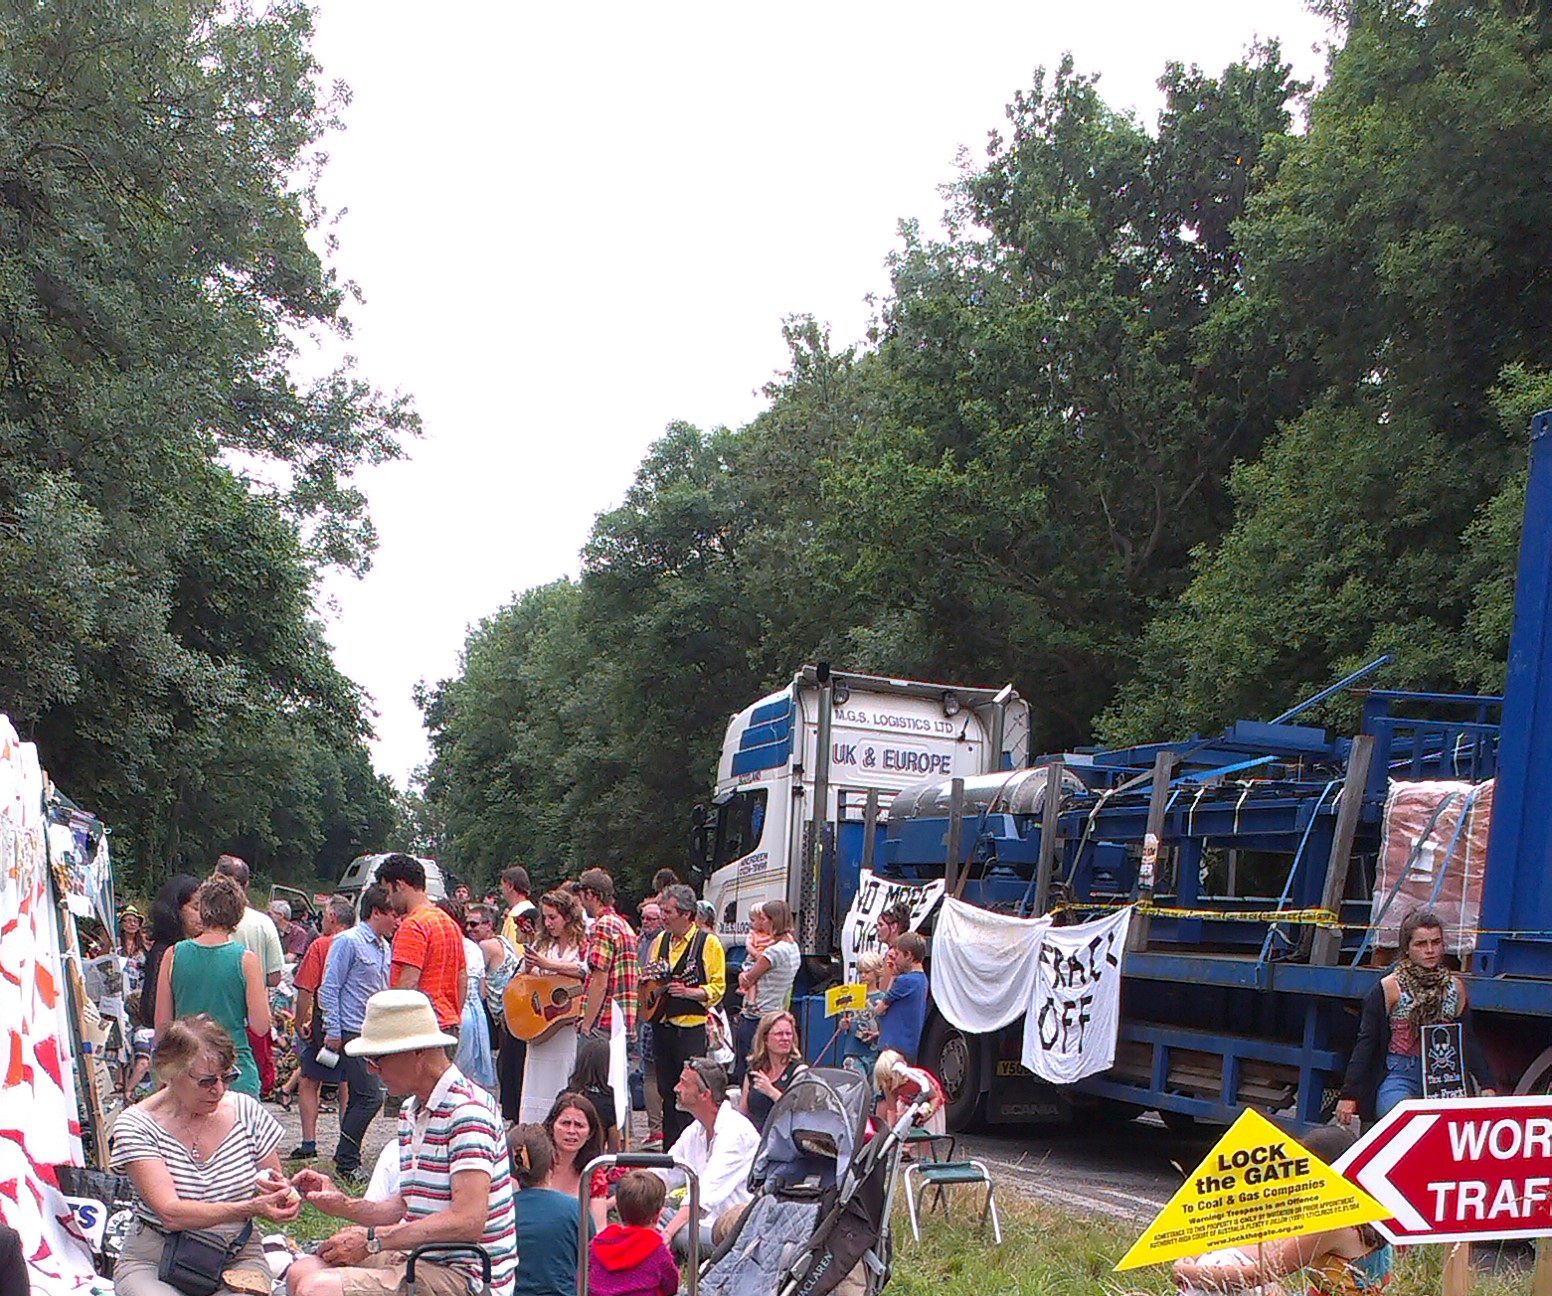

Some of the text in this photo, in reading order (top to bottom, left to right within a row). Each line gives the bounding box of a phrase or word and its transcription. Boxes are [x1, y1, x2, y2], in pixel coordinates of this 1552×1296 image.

[835, 709, 954, 733] M.G.S. LOGISTICS LTD
[833, 743, 952, 775] UK & EUROPE
[1038, 997, 1093, 1054] OFF
[1448, 1118, 1552, 1162] WOR
[1218, 1142, 1288, 1171] LOCK
[1195, 1157, 1310, 1195] the GATE
[1182, 1179, 1325, 1214] To Coal & Gas Companies
[1227, 1205, 1263, 1217] Trespass
[1287, 1195, 1320, 1206] Offence
[1427, 1177, 1551, 1222] TRAF
[1206, 1224, 1304, 1248] www.lockthegate.org.au
[1207, 1219, 1233, 1231] PROPERTY
[1240, 1215, 1257, 1223] ONLY
